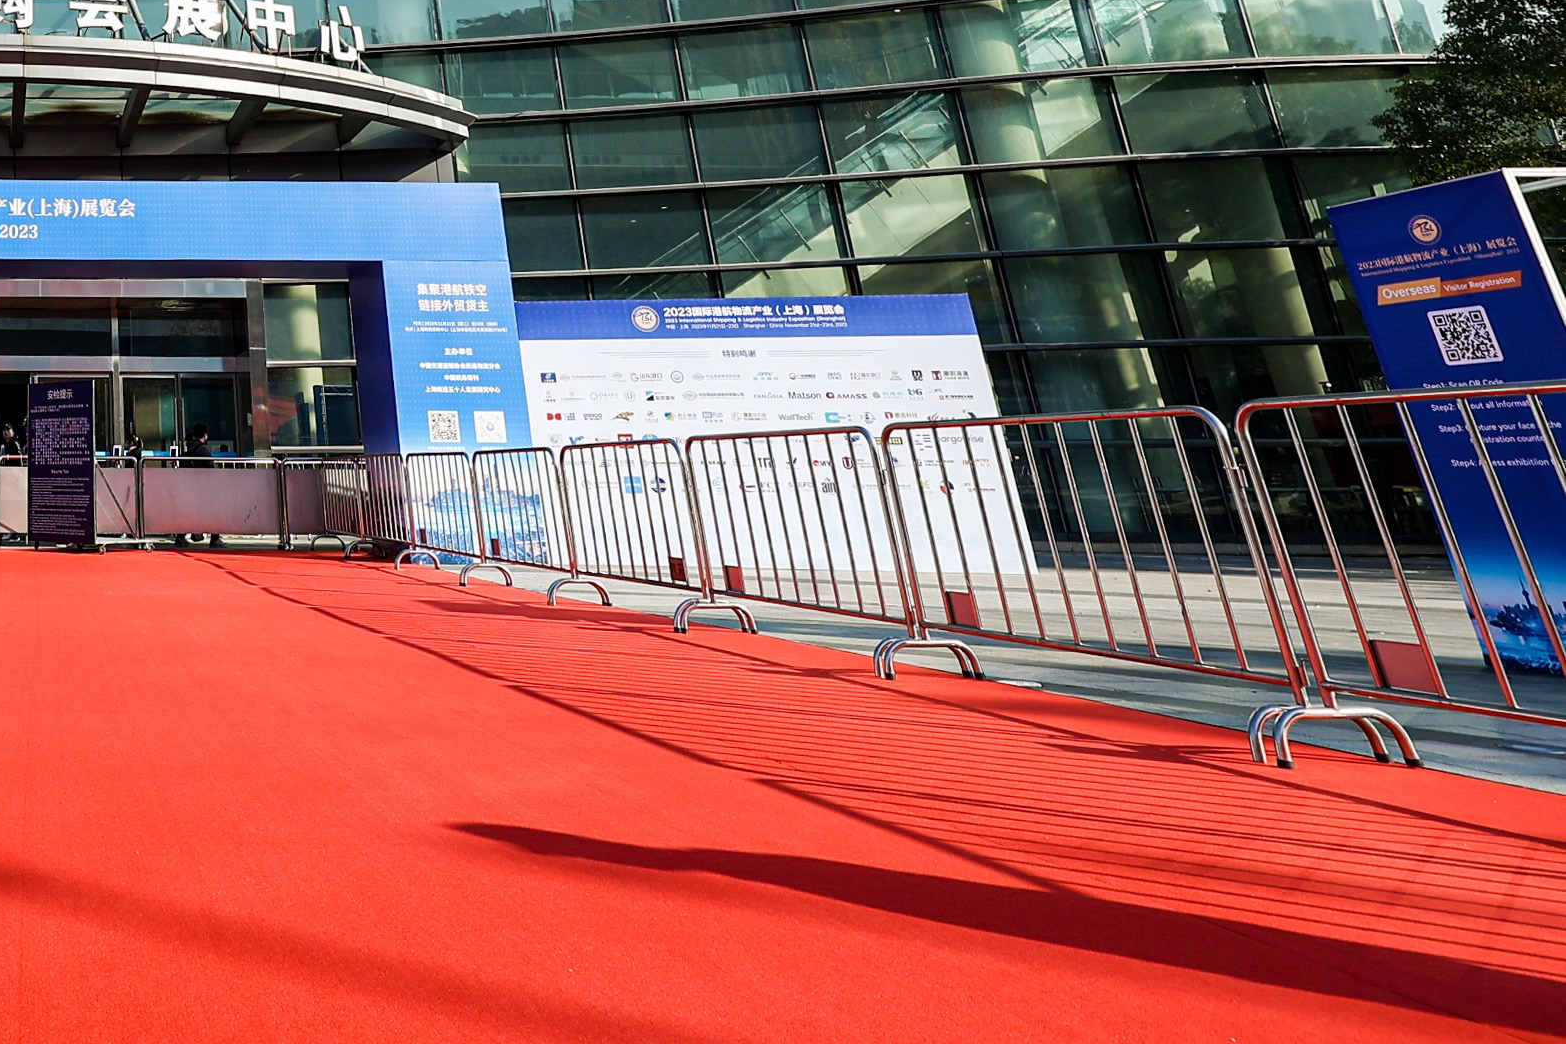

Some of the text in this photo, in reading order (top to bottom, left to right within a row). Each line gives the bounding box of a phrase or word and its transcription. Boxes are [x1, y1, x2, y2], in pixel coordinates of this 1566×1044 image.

[0, 224, 39, 239] 2023
[416, 283, 487, 296] 集聚港航铁空
[1382, 275, 1517, 299] Overseas Visitor Registration
[418, 299, 489, 312] 链接外贸货主
[47, 388, 74, 401] 安检提示
[788, 391, 822, 400] Matson
[1430, 399, 1543, 412] Step2: out all informatn
[1438, 424, 1464, 434] Step3:
[1465, 424, 1498, 432] Cture
[1498, 422, 1517, 433] your
[1517, 421, 1536, 430] face
[1516, 435, 1544, 443] counte
[1450, 458, 1477, 469] Step4:
[1478, 459, 1506, 467] Aess
